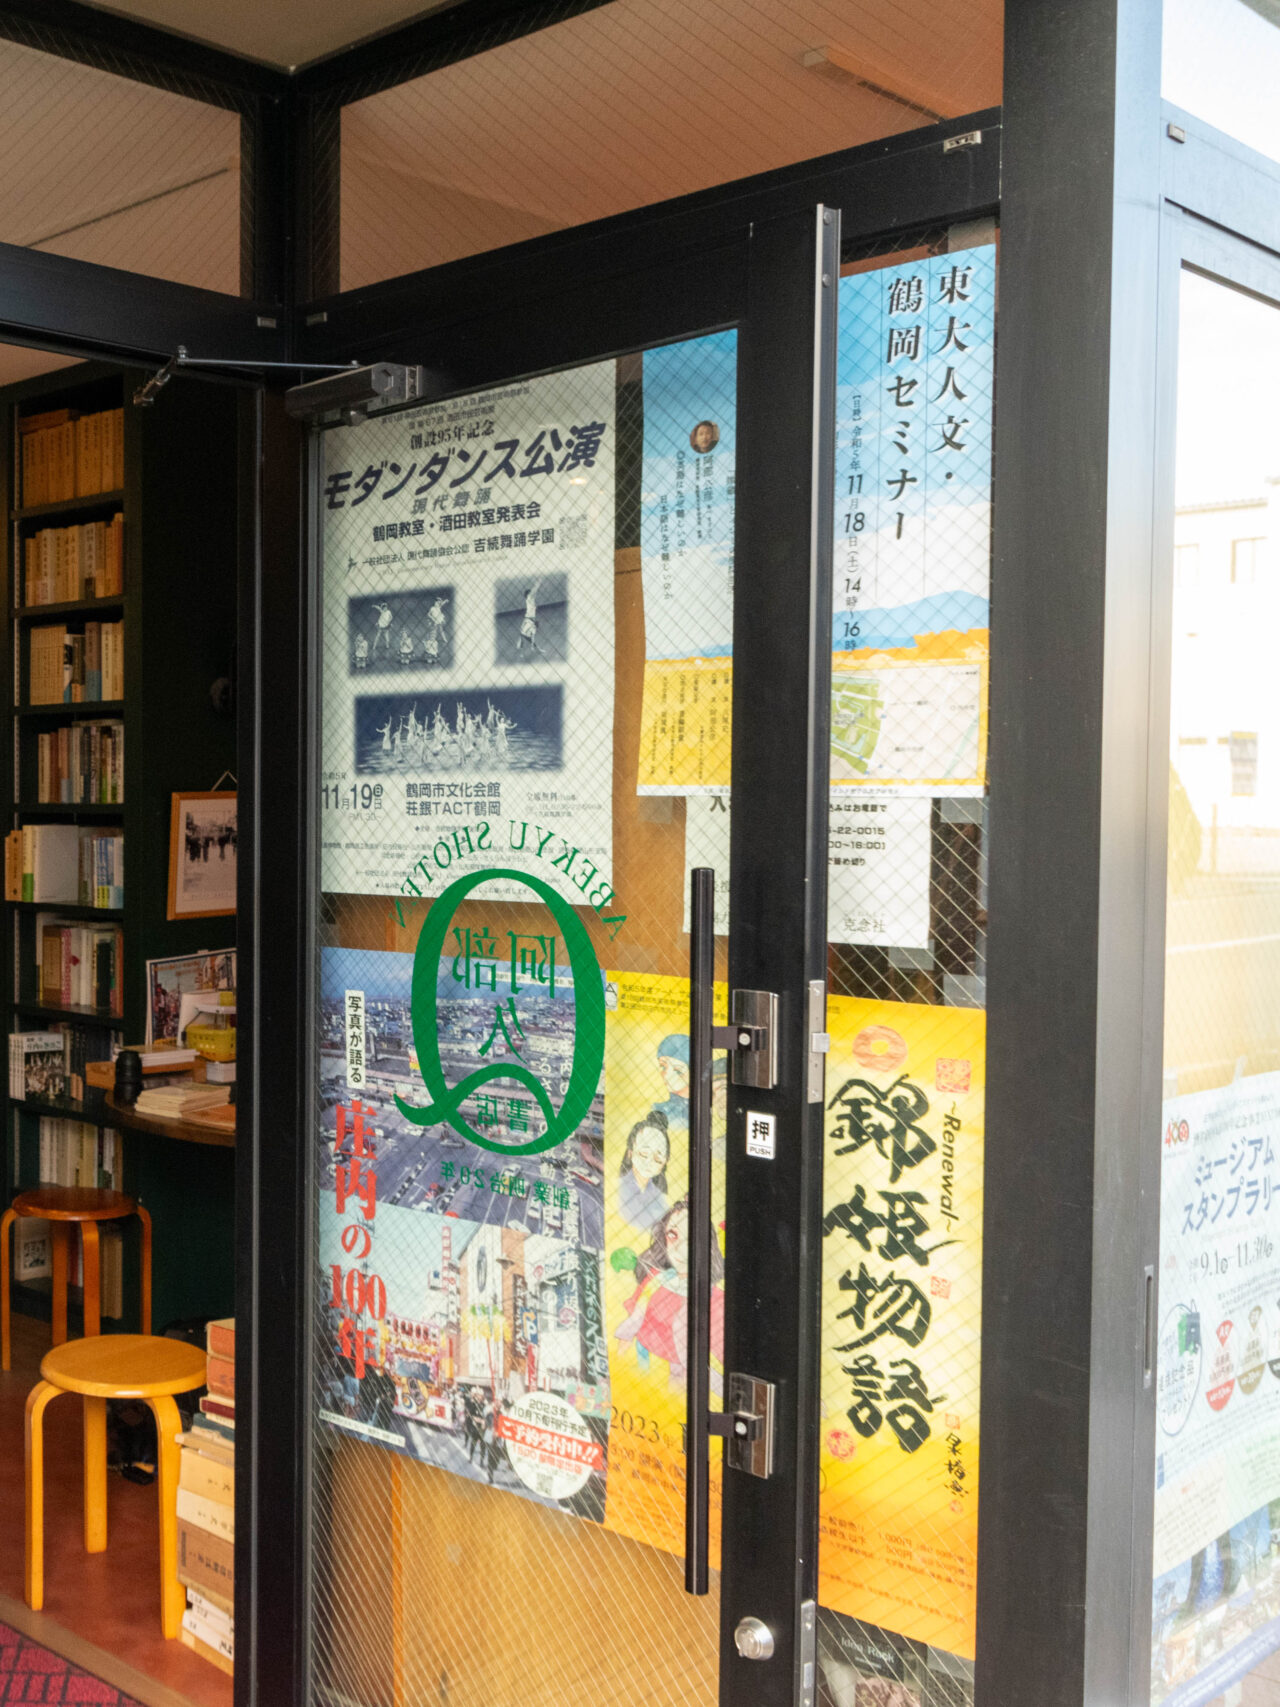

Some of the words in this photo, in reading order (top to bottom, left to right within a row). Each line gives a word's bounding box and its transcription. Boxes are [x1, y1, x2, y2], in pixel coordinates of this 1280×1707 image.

[886, 275, 923, 540] 鶴岡セミナー
[410, 420, 495, 450] 創設95年記念
[324, 421, 607, 510] モダンダンス公演
[373, 501, 541, 543] 鶴岡教室・酒田教室発表会
[406, 783, 501, 798] 鶴岡市文化会館
[406, 801, 501, 817] 荘銀TACT鶴岡
[347, 995, 363, 1084] 写真が語る
[751, 1119, 770, 1142] 押
[749, 1145, 772, 1156] PUSH
[1194, 1135, 1276, 1187] ミュージアム
[528, 1399, 568, 1417] 2023年
